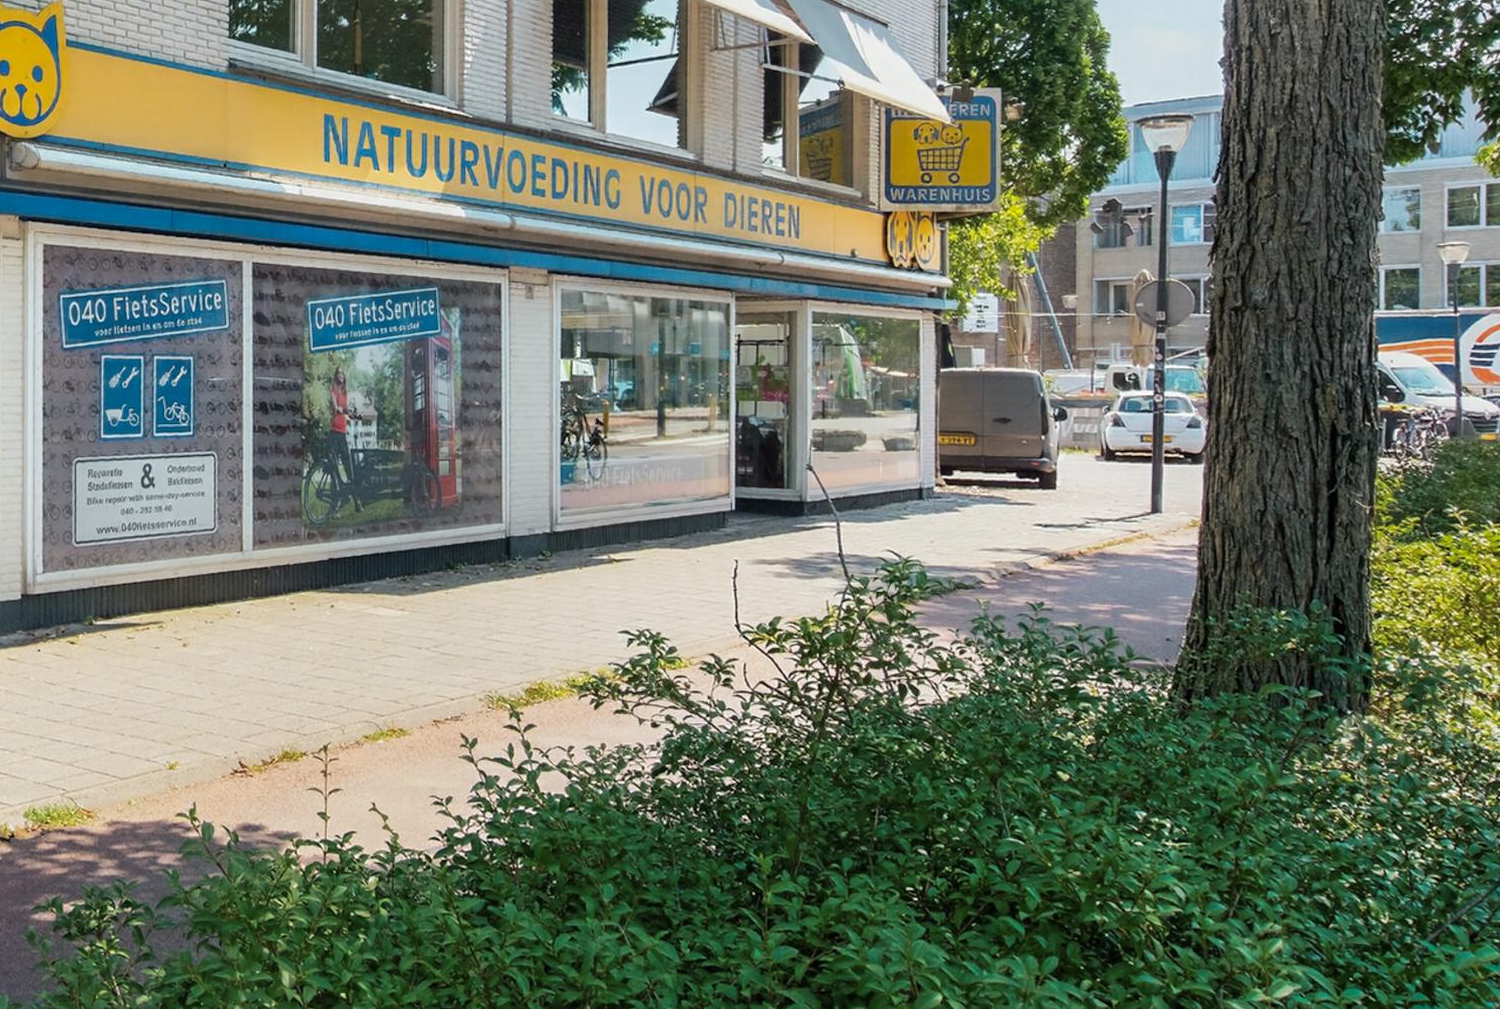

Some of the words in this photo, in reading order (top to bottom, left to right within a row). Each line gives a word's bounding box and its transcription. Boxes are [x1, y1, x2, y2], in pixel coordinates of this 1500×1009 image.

[946, 103, 990, 116] EREN
[323, 112, 621, 210] NATUURVOEDING
[639, 175, 708, 224] VOOR
[724, 192, 801, 239] DIEREN
[890, 188, 990, 202] WARENHUIS
[68, 298, 107, 326] 040
[113, 289, 222, 321] FietsService
[314, 304, 345, 330] 040
[349, 296, 435, 326] FietsService
[140, 463, 156, 489] &
